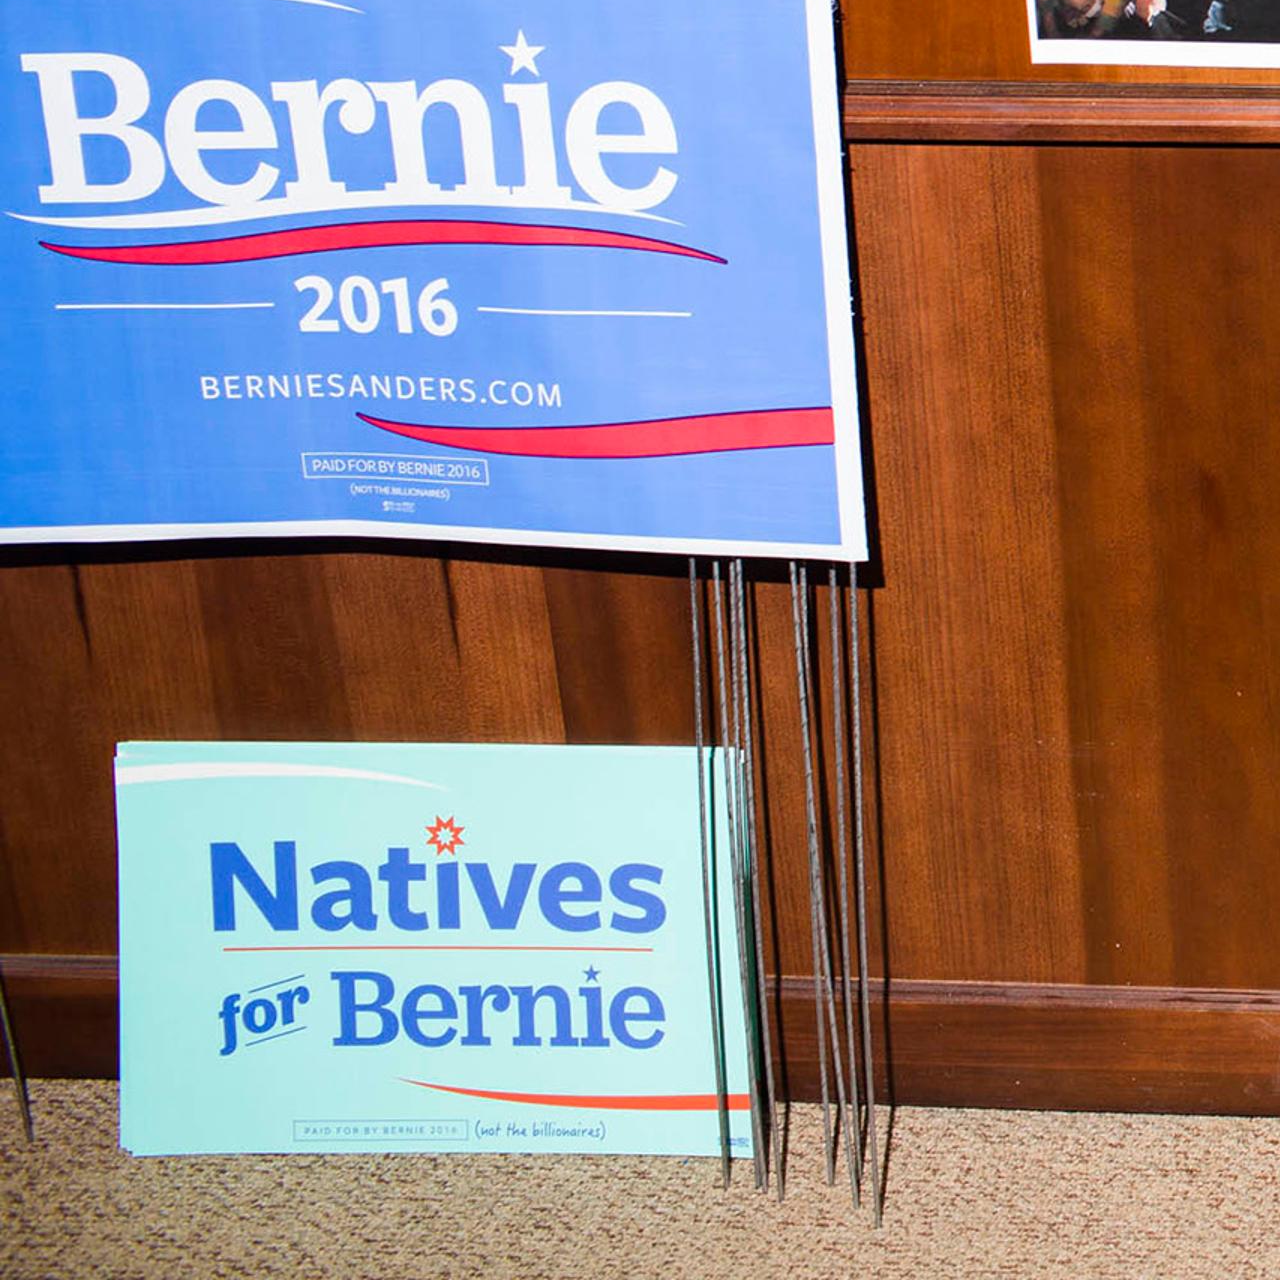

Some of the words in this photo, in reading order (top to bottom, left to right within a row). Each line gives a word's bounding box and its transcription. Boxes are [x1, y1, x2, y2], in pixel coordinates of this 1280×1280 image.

[20, 30, 679, 211] Bernie
[293, 274, 459, 338] 2016
[200, 374, 564, 409] BERNIESANDERS.COM
[312, 459, 345, 473] PAID
[348, 459, 377, 473] FOR
[379, 460, 396, 474] BY
[398, 462, 446, 478] BERNIE
[447, 463, 481, 479] 2016
[209, 816, 667, 933] Natives
[218, 983, 310, 1056] for
[330, 964, 666, 1050] Bernie
[304, 1126, 332, 1136] PAID
[336, 1126, 359, 1136] FOR
[363, 1126, 379, 1136] BY
[383, 1126, 426, 1136] BERNIE
[429, 1125, 458, 1135] 2016
[474, 1120, 501, 1140] (not
[506, 1121, 527, 1137] the
[532, 1120, 607, 1141] billionaires)
